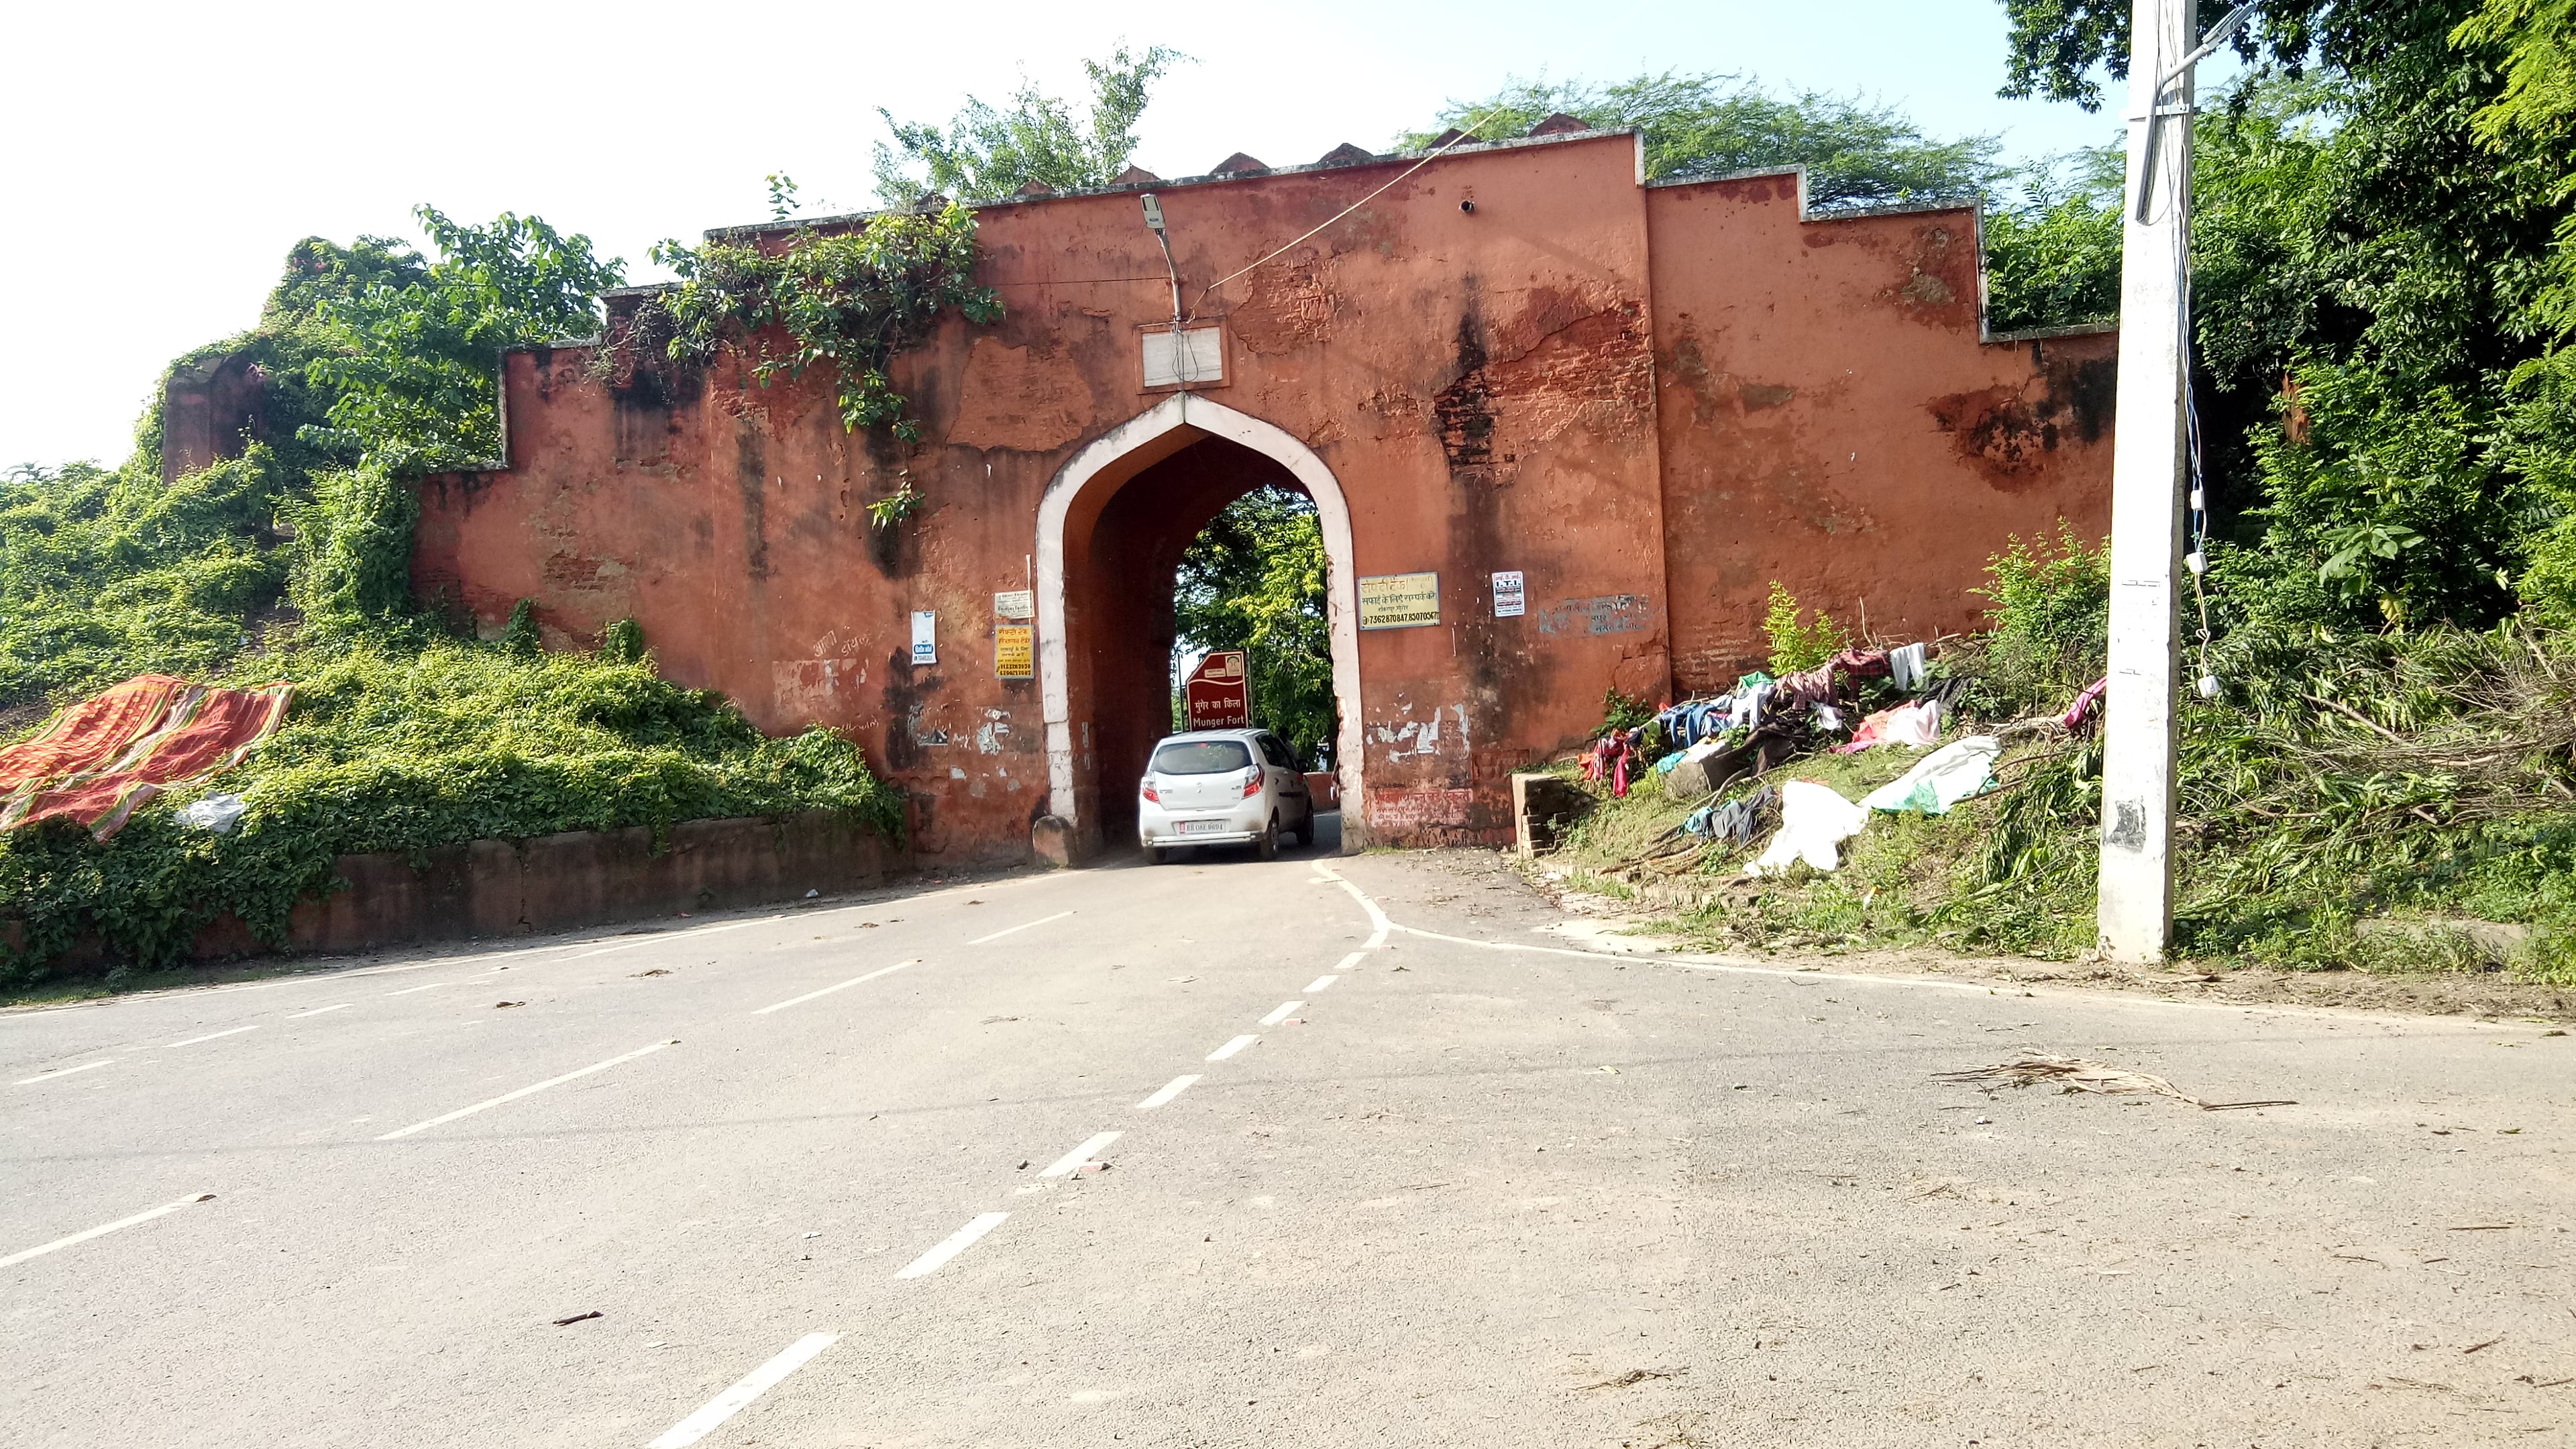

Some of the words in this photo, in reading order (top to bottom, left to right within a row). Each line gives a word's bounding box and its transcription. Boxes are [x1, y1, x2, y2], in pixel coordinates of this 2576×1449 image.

[1382, 594, 1390, 604] के
[1194, 699, 1209, 714] मुंगेर
[1212, 701, 1221, 709] का
[1224, 698, 1240, 708] किला
[1193, 717, 1224, 728] Munger
[1227, 714, 1244, 724] Fort
